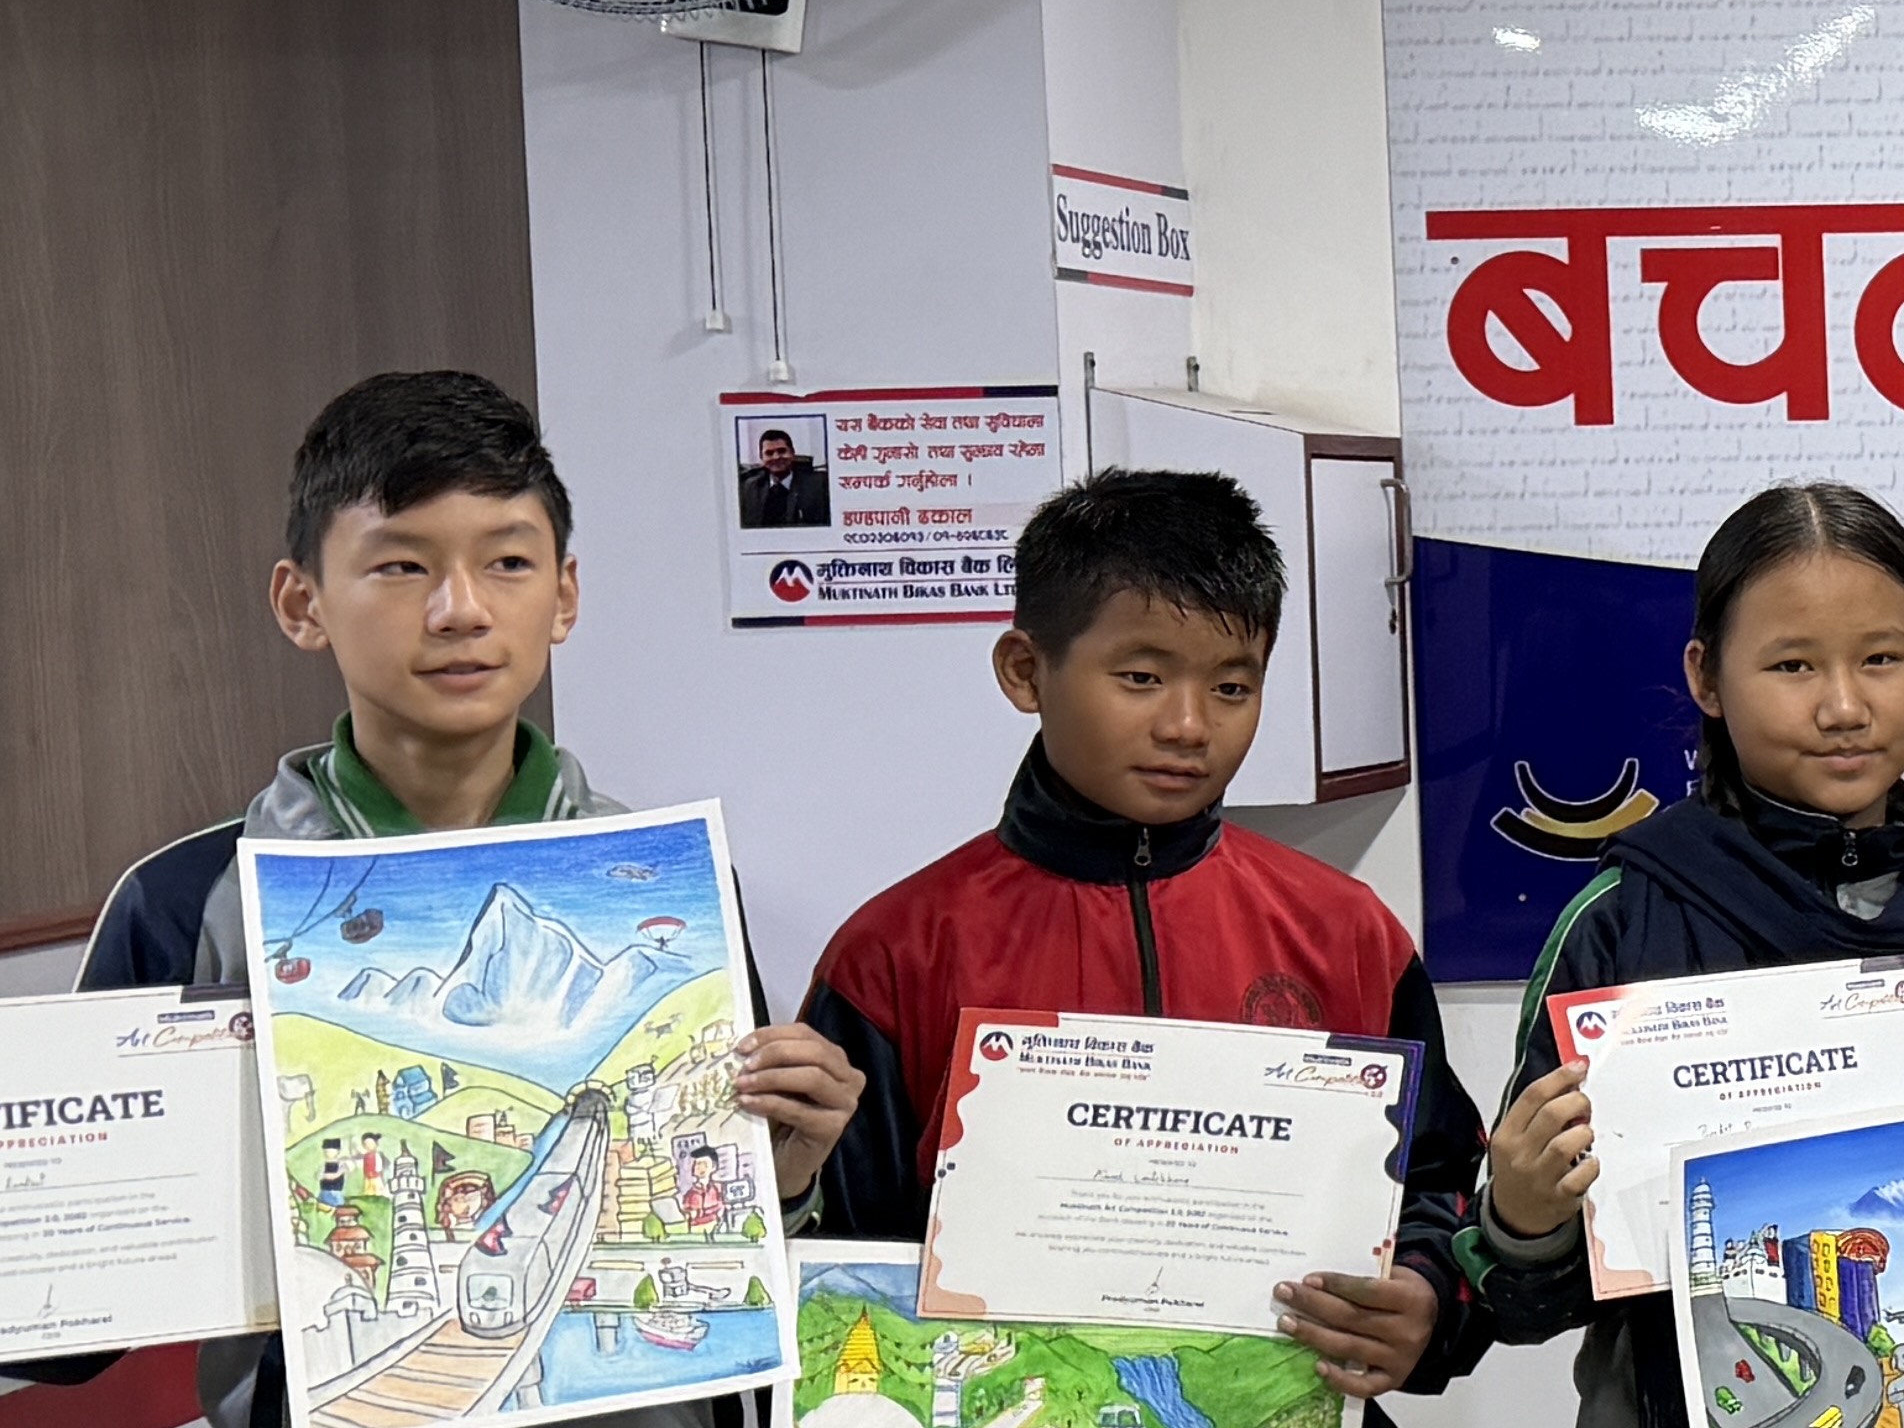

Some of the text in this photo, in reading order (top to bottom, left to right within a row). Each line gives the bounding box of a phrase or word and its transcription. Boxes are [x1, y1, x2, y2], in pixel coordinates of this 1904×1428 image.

[1056, 193, 1192, 262] Suggestion Box
[927, 445, 956, 460] तथा
[900, 556, 955, 574] विकास
[818, 583, 989, 600] MUKTINATH BIKAS BANK
[1673, 1046, 1858, 1088] CERTIFICATE
[1067, 1102, 1293, 1141] CERTIFICATE
[1136, 1138, 1239, 1155] APPRECIATION
